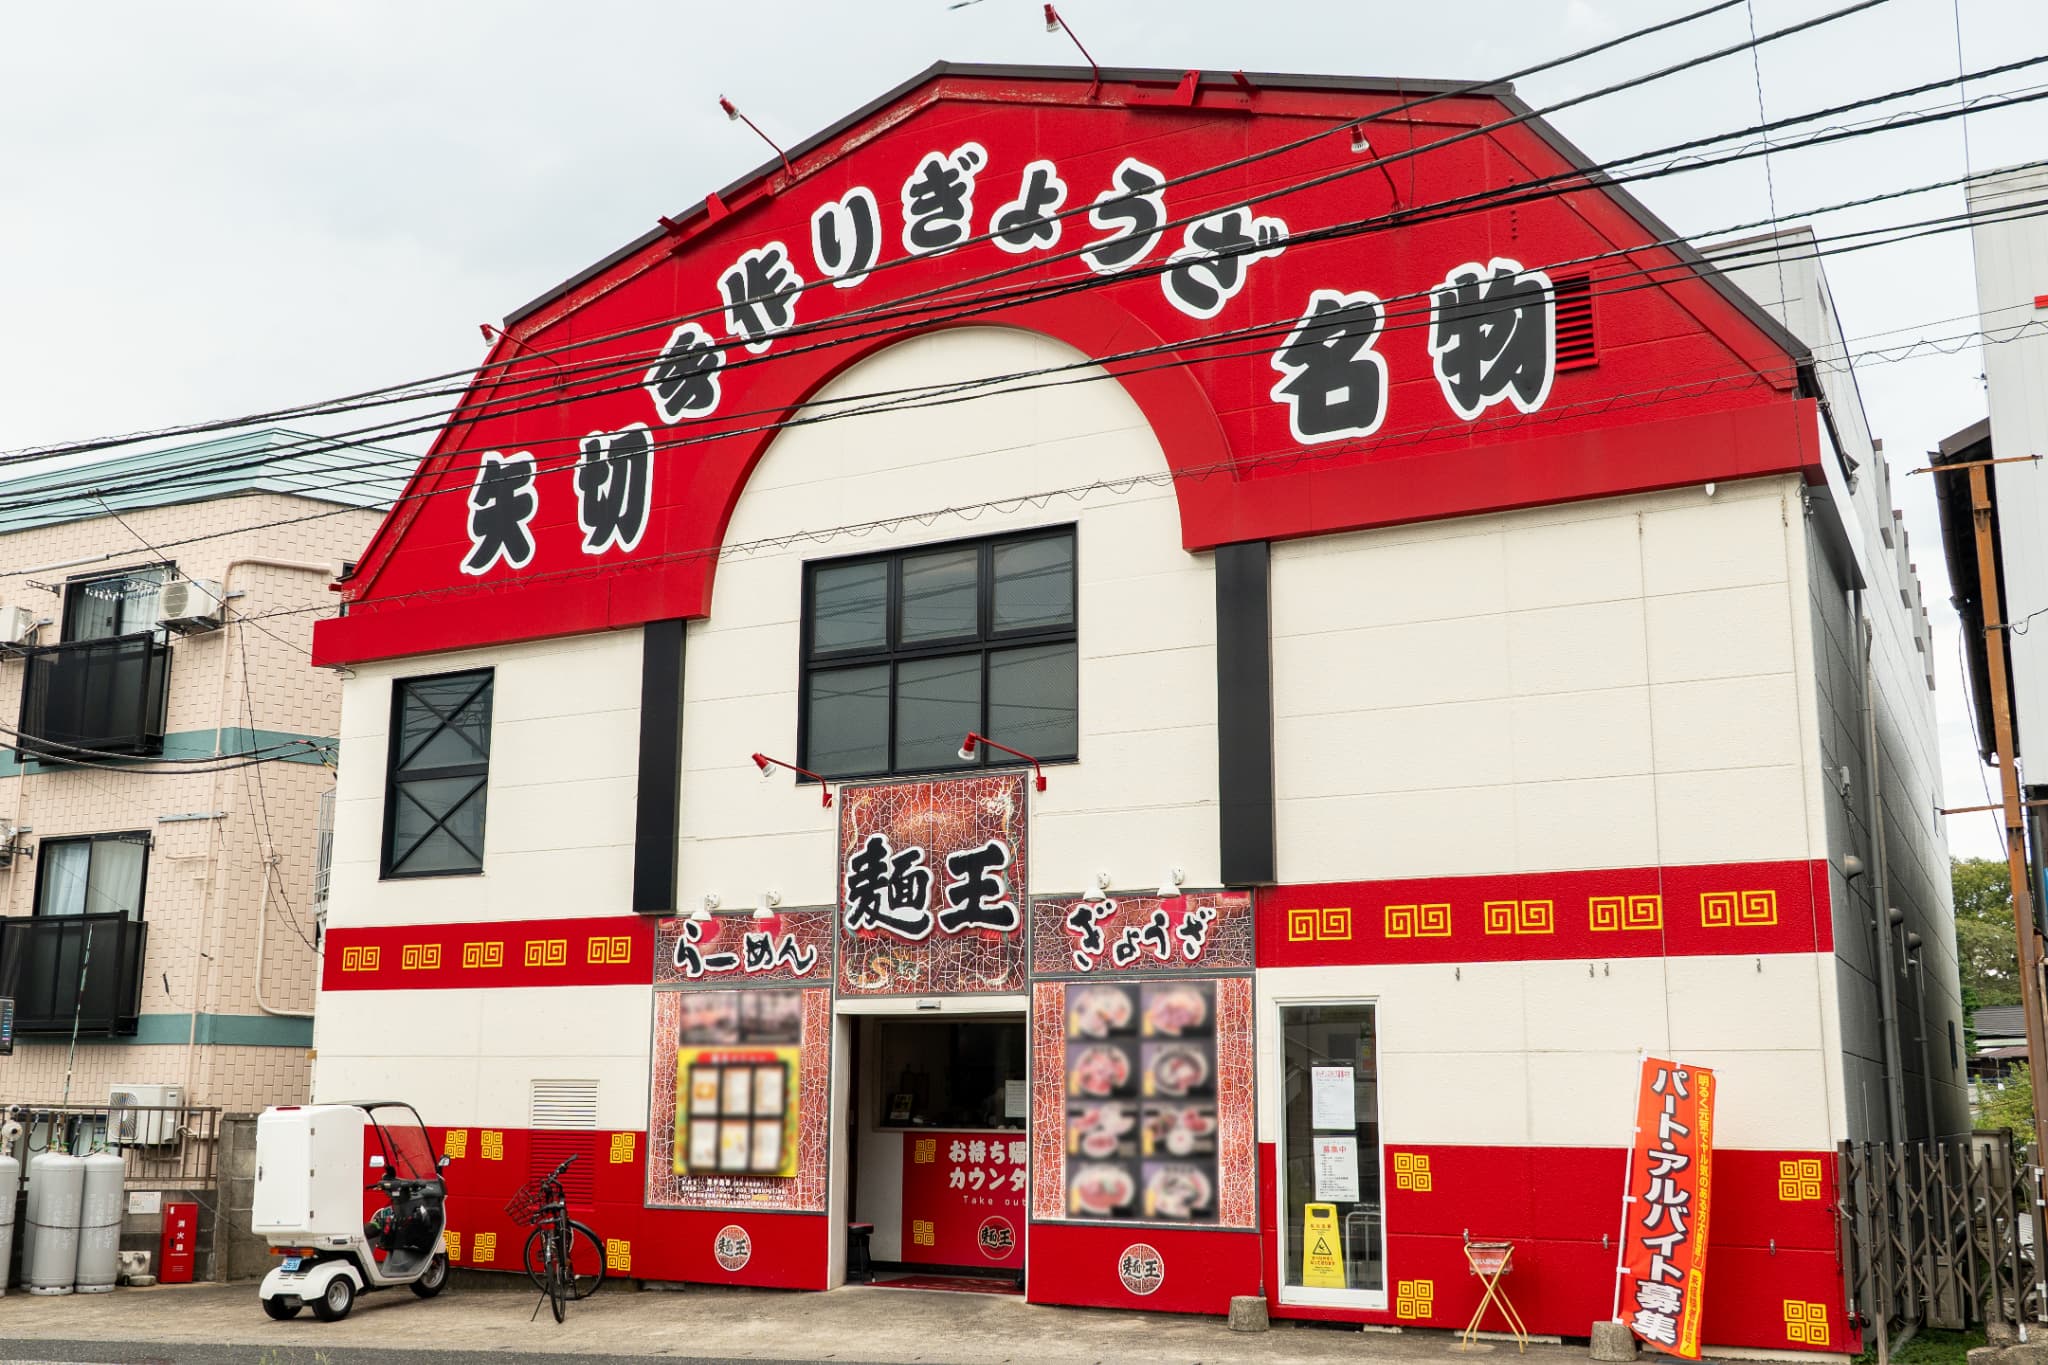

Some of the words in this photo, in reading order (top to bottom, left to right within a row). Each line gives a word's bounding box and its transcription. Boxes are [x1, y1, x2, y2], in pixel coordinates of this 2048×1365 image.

[1270, 257, 1556, 447] 名物
[459, 421, 655, 576] 矢切
[844, 832, 1021, 941] 麺王
[1067, 898, 1217, 972] ぎょうざ
[674, 919, 818, 978] らーめん
[963, 1195, 994, 1206] Take
[1630, 1068, 1690, 1346] パート・アルバイト募集
